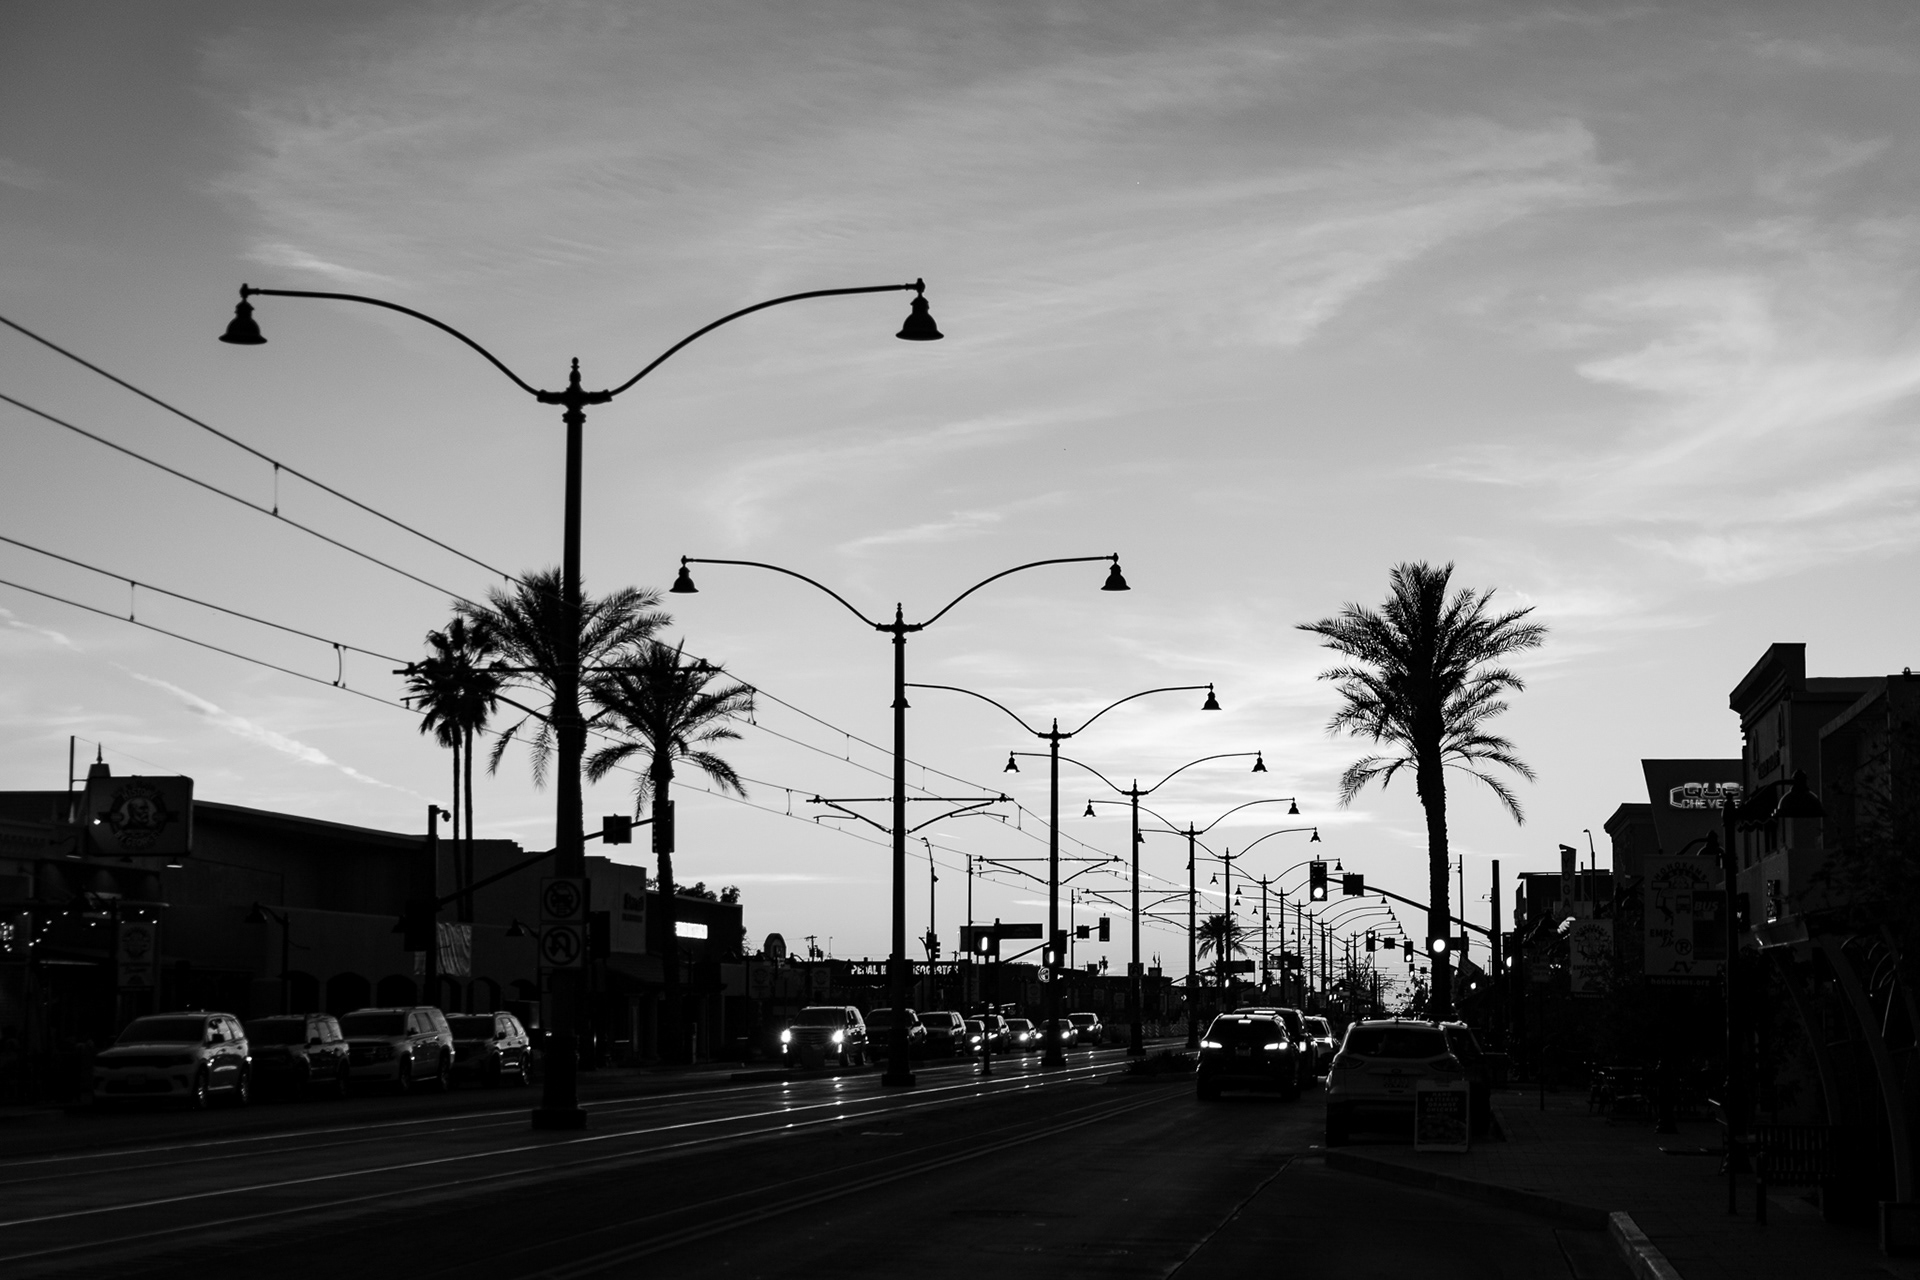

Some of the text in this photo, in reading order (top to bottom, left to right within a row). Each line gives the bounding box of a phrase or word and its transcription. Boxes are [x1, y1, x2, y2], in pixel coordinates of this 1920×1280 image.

[1681, 799, 1741, 809] CHEVEE
[1653, 861, 1708, 881] HOHOKAMS
[1562, 857, 1571, 908] YOGA
[1693, 901, 1719, 912] BUS
